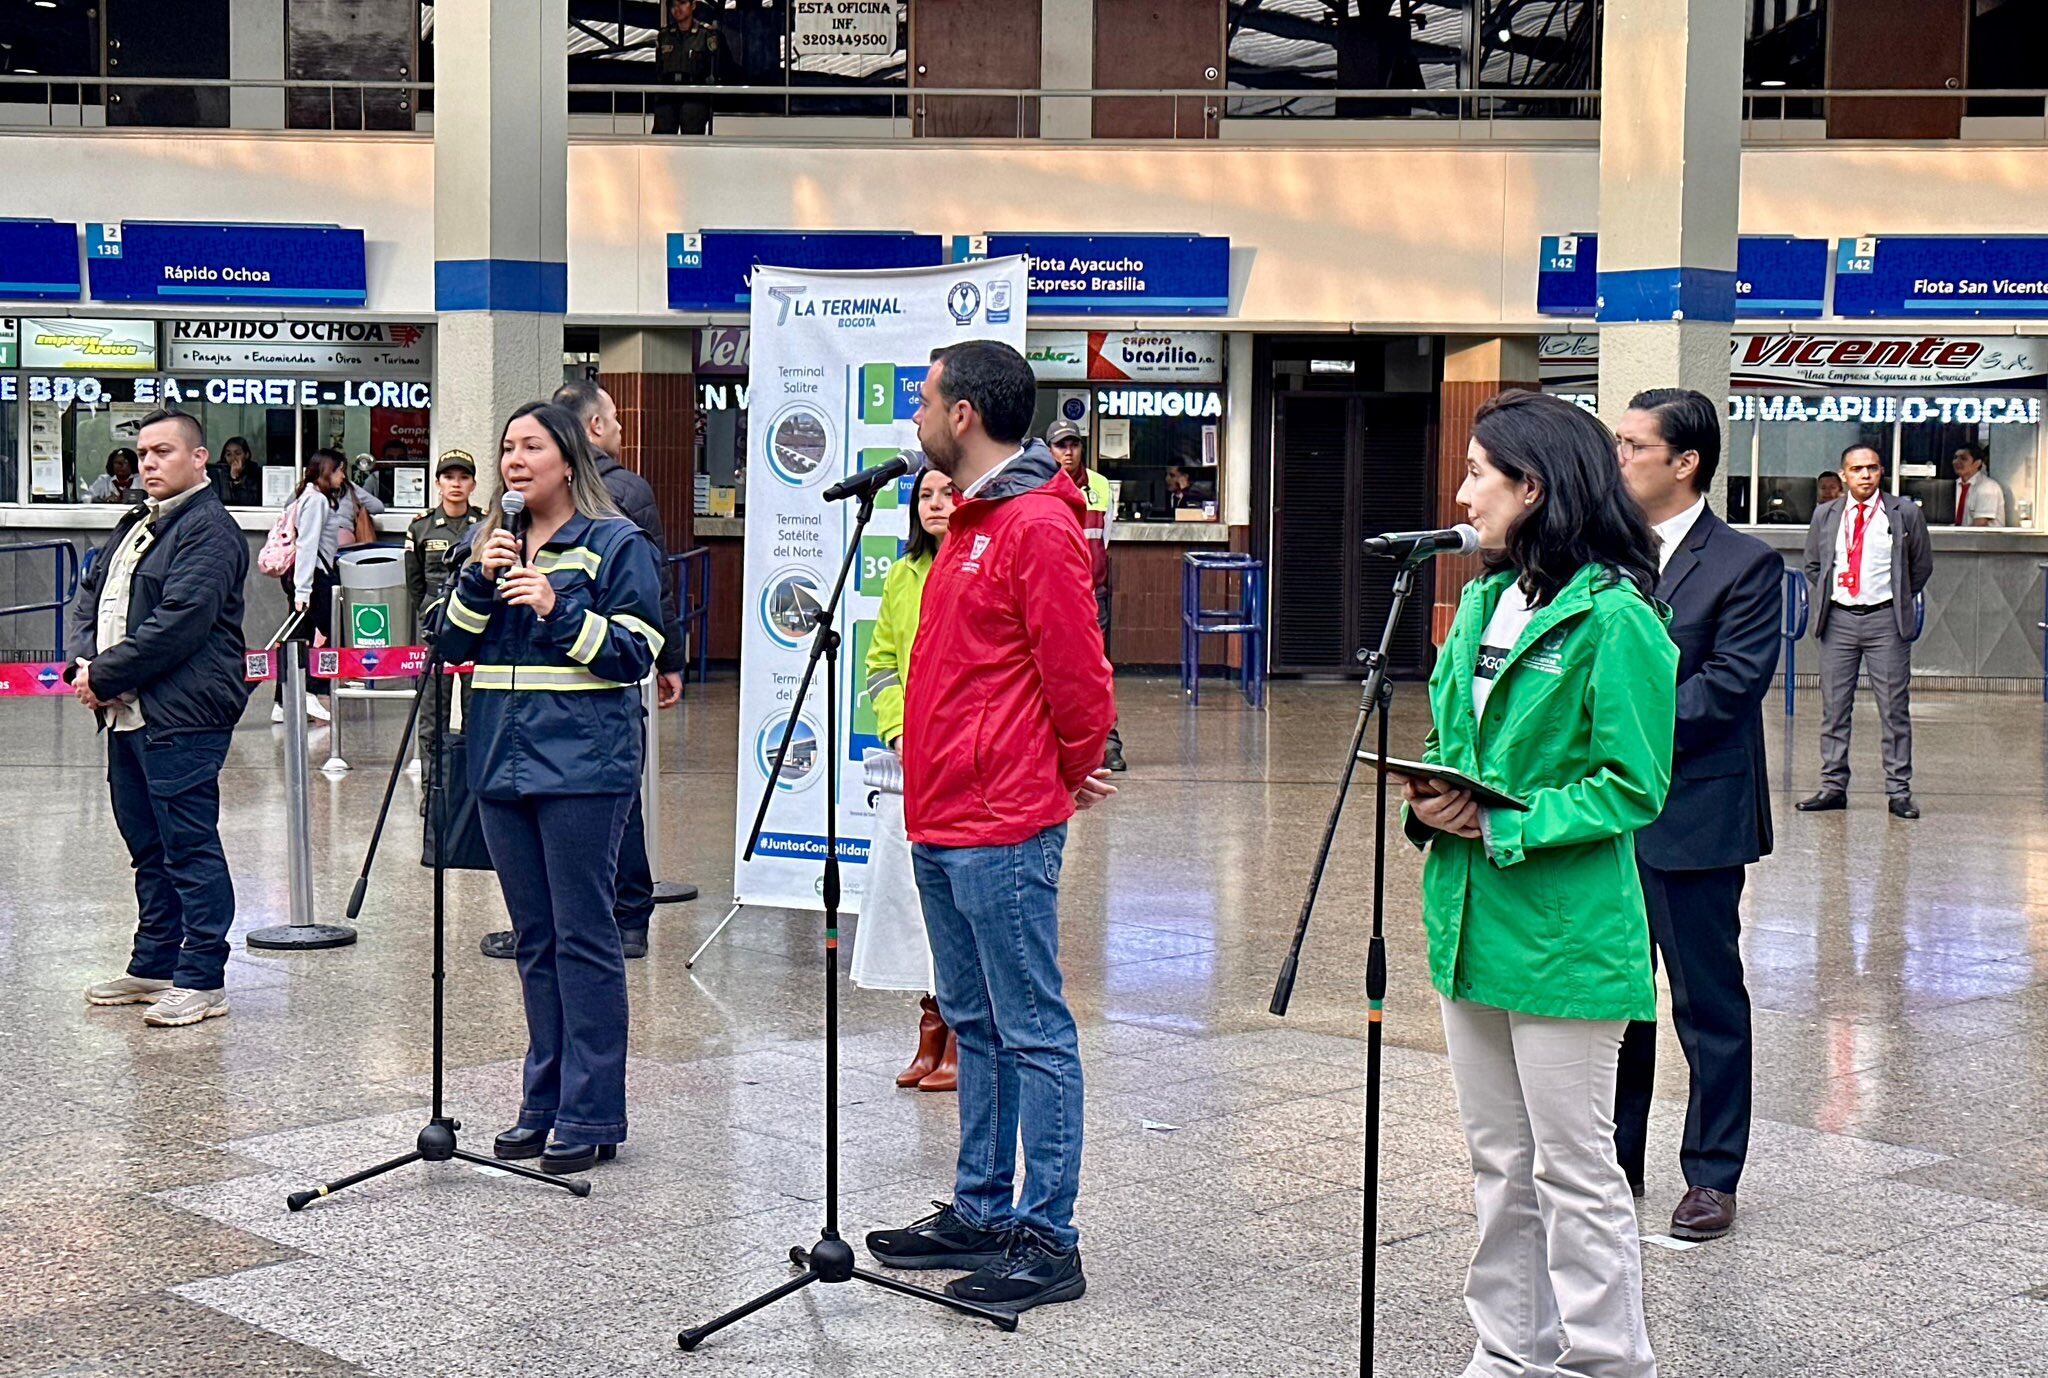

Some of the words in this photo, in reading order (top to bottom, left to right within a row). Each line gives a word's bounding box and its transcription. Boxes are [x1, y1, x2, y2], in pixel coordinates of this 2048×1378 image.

[798, 2, 834, 14] ESTA
[837, 2, 891, 14] OFICINA
[832, 18, 857, 30] INF.
[802, 34, 887, 47] 3203449500
[109, 228, 117, 238] 2
[688, 237, 697, 248] 2
[974, 240, 982, 250] 2
[1564, 241, 1572, 251] 2
[1861, 241, 1870, 252] 2
[97, 244, 119, 255] 138
[677, 254, 700, 265] 140
[1028, 257, 1066, 272] Flota
[1069, 257, 1144, 275] Ayacucho
[1550, 257, 1573, 269] 142
[1847, 259, 1870, 270] 142
[164, 265, 218, 283] Rápido
[222, 266, 271, 282] Ochoa
[1028, 276, 1087, 293] Expreso
[1091, 277, 1146, 292] Brasilia
[1913, 279, 1955, 294] Flota
[1958, 279, 1989, 294] San
[1992, 279, 2048, 294] Vicente
[794, 299, 816, 316] LA
[821, 297, 902, 316] TERMINAL
[837, 315, 876, 328] BOGOTÁ
[289, 321, 384, 342] OCHOA
[35, 334, 101, 348] Empresa
[1122, 336, 1172, 348] expreso
[82, 344, 138, 355] Arauca
[1122, 346, 1197, 364] brasilia
[1741, 335, 1985, 369] Vicente
[192, 351, 232, 364] Pasajes
[252, 352, 316, 364] Encomiendas
[336, 353, 362, 364] Giros
[381, 353, 420, 365] Turismo
[778, 366, 825, 378] Terminal
[1827, 370, 1870, 382] Empresa
[1874, 370, 1908, 383] Segura
[1909, 373, 1917, 381] a
[1920, 373, 1931, 381] su
[783, 382, 818, 394] Salitre
[700, 384, 727, 411] N
[872, 384, 885, 407] 3
[775, 513, 822, 526] Terminal
[778, 529, 819, 542] Satélite
[773, 545, 790, 557] del
[792, 546, 823, 557] Norte
[863, 556, 892, 579] 39
[400, 661, 415, 670] NO
[772, 672, 818, 686] Termial
[776, 690, 792, 702] del
